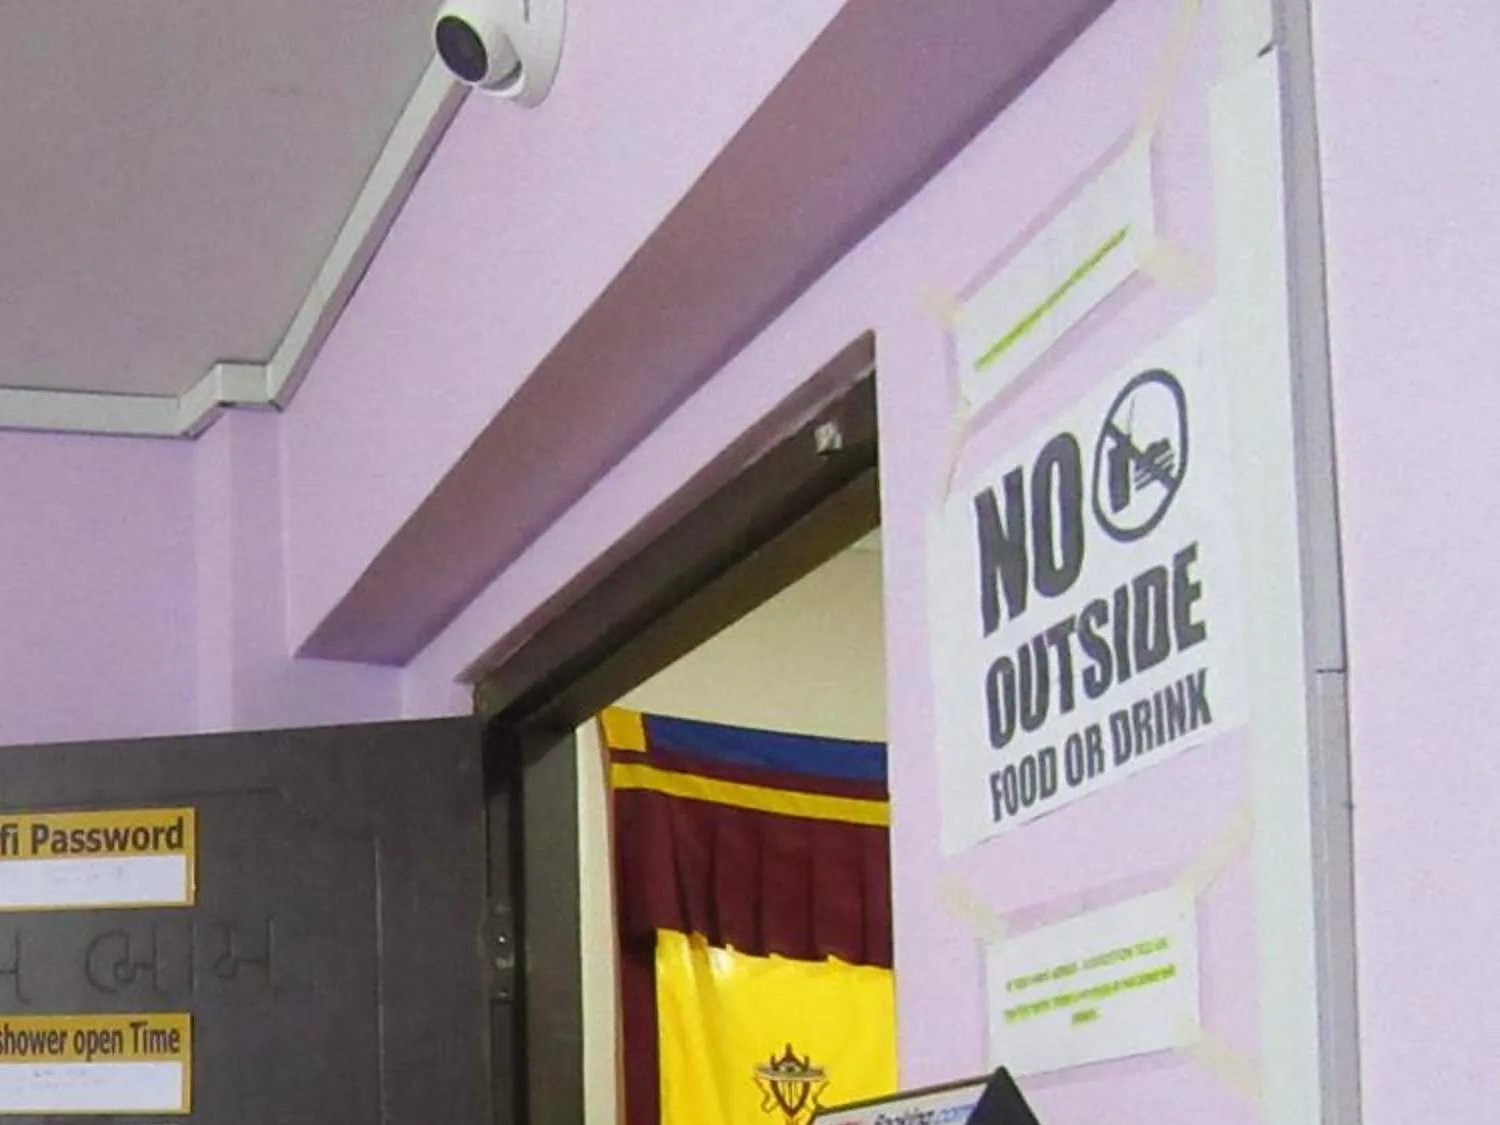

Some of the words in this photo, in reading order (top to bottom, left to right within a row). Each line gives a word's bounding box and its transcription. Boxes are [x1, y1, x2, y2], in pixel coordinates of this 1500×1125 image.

[973, 430, 1085, 639] NO
[985, 540, 1208, 751] OUTSIDE
[989, 745, 1057, 823] FOOD
[1064, 721, 1106, 788] OR
[1109, 667, 1213, 768] DRINK
[30, 816, 185, 854] Password
[73, 1029, 123, 1062] open
[130, 1021, 181, 1054] Time
